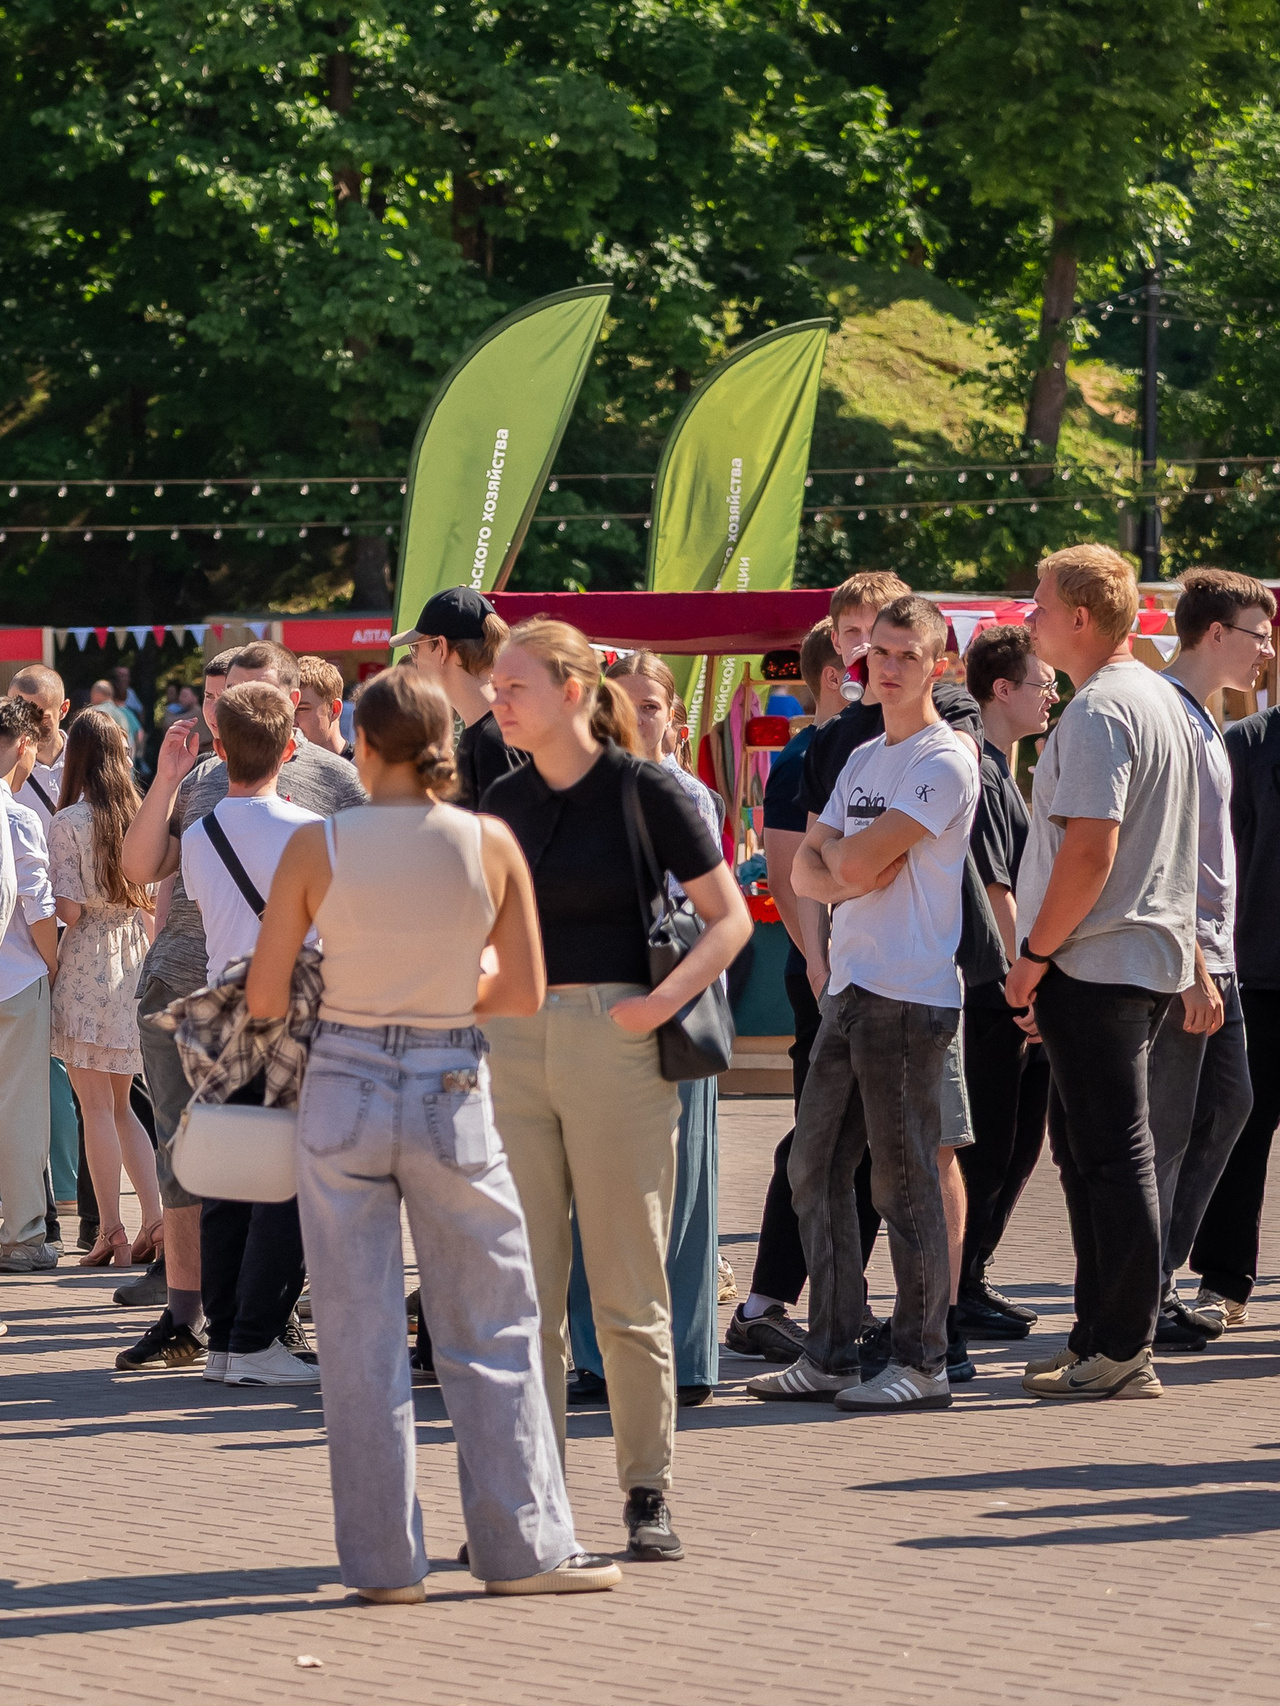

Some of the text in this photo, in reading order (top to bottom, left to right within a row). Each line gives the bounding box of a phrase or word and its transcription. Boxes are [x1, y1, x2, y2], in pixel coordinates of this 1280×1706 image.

[470, 428, 509, 593] ьского хозяйства
[726, 458, 743, 543] хозяйства
[712, 557, 750, 728] сийской ции
